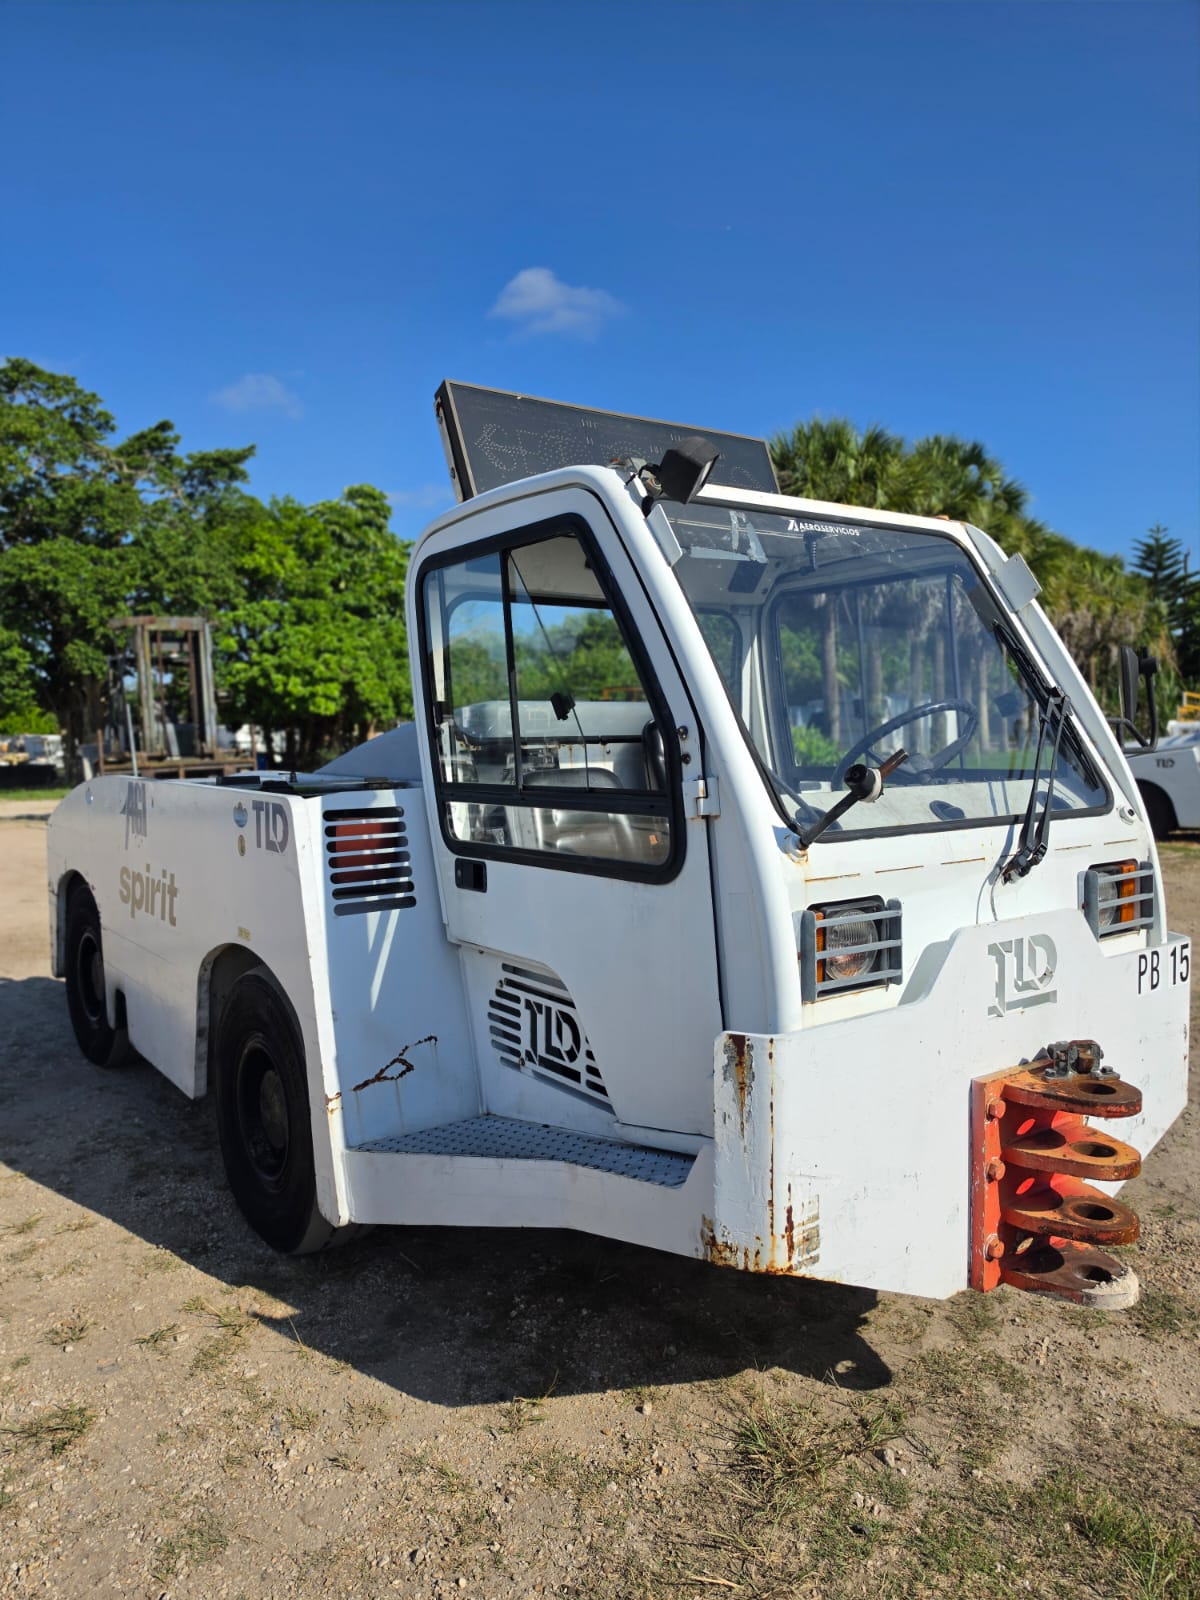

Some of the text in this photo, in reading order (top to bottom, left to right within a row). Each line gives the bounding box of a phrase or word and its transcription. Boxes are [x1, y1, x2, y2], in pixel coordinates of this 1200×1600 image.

[1156, 758, 1175, 768] TLD
[252, 799, 289, 854] TLD
[120, 864, 178, 926] spirit
[987, 933, 1058, 1016] TLD
[1138, 943, 1190, 995] PB 15
[524, 998, 581, 1066] TLD
